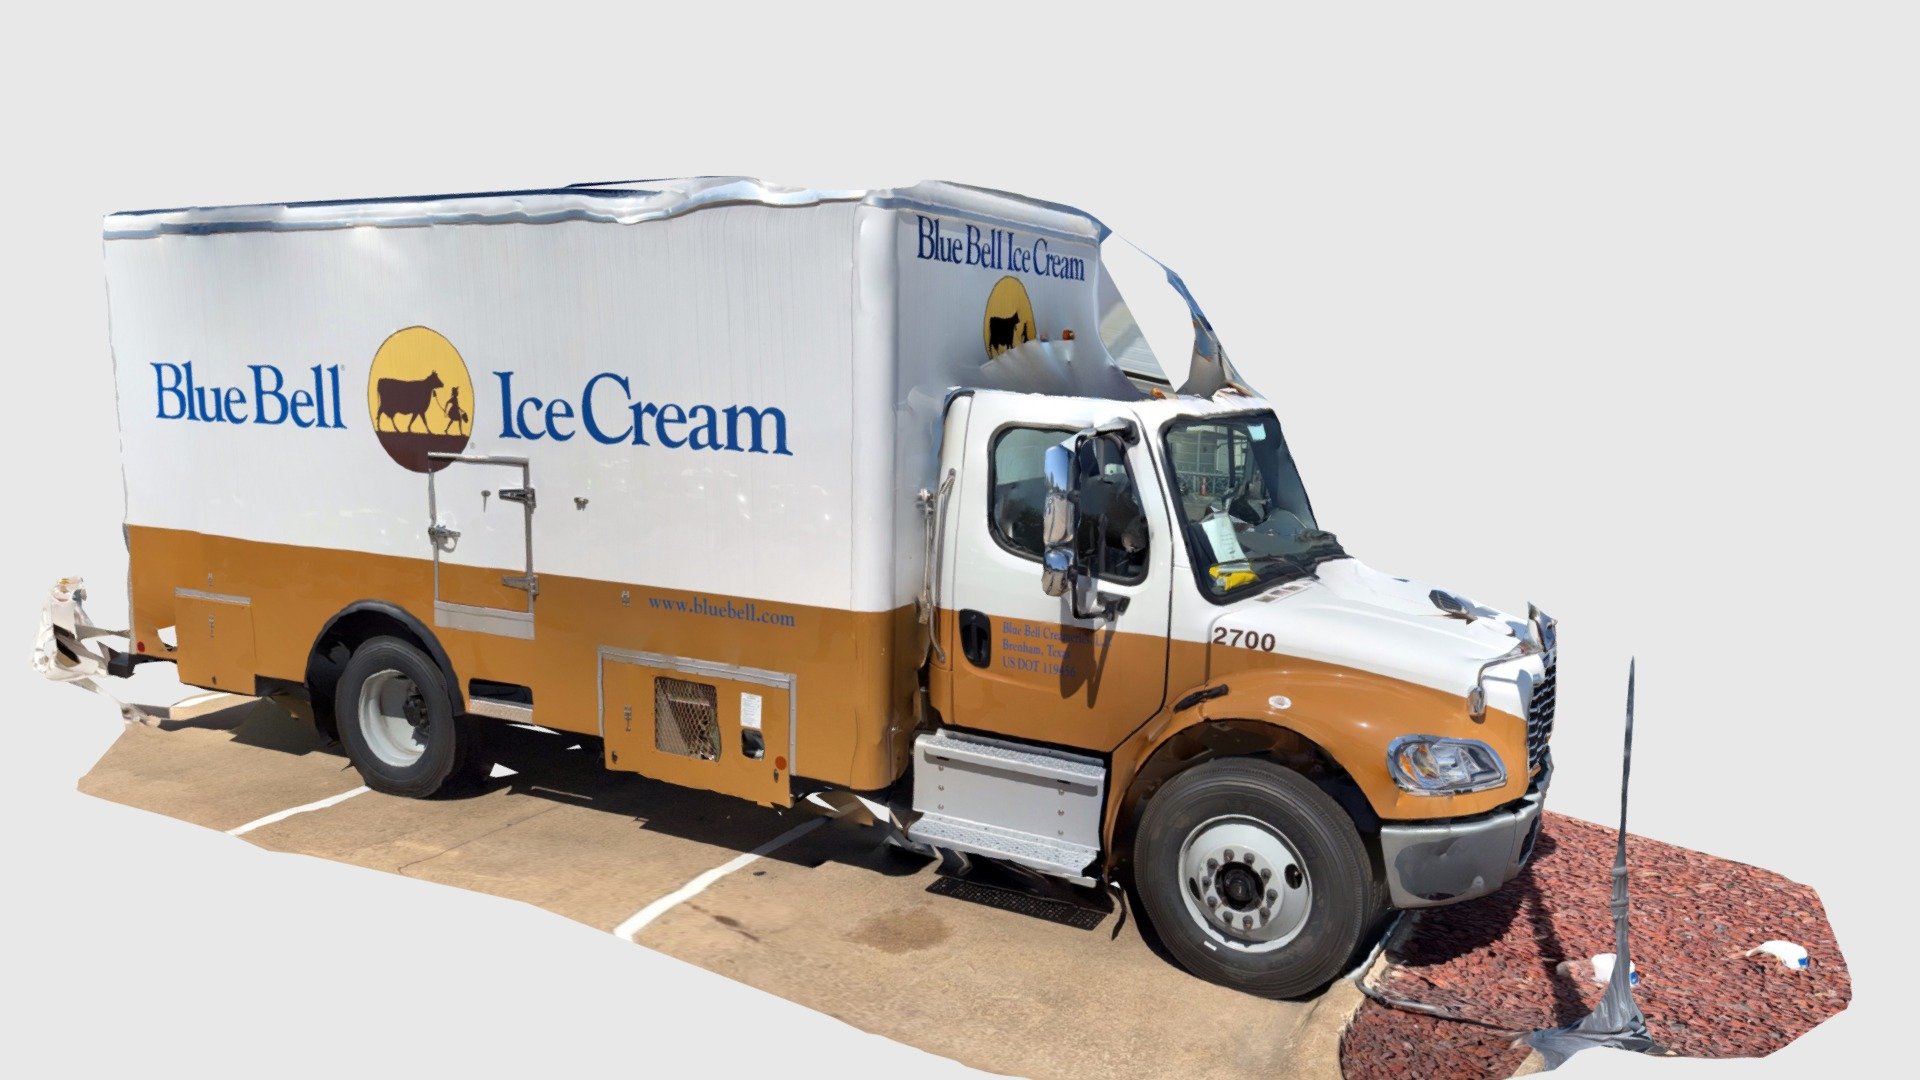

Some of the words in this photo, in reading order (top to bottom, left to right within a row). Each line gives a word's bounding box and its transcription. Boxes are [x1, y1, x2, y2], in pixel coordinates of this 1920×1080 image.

[917, 214, 963, 265] Blue
[966, 224, 1003, 270] Bell
[1007, 231, 1031, 273] Ice
[1033, 238, 1085, 281] Cream
[150, 360, 248, 425] Blue
[247, 363, 348, 430] Bell
[492, 371, 576, 442] Ice
[581, 372, 794, 456] Cream
[648, 596, 796, 627] www.bluebell.com
[1003, 621, 1021, 636] Blue
[1023, 624, 1040, 639] Bell
[1213, 626, 1276, 652] 2700
[1002, 638, 1044, 657] Brenham,
[1047, 643, 1071, 660] Texas
[1002, 655, 1016, 670] US
[1017, 657, 1040, 673] DOT
